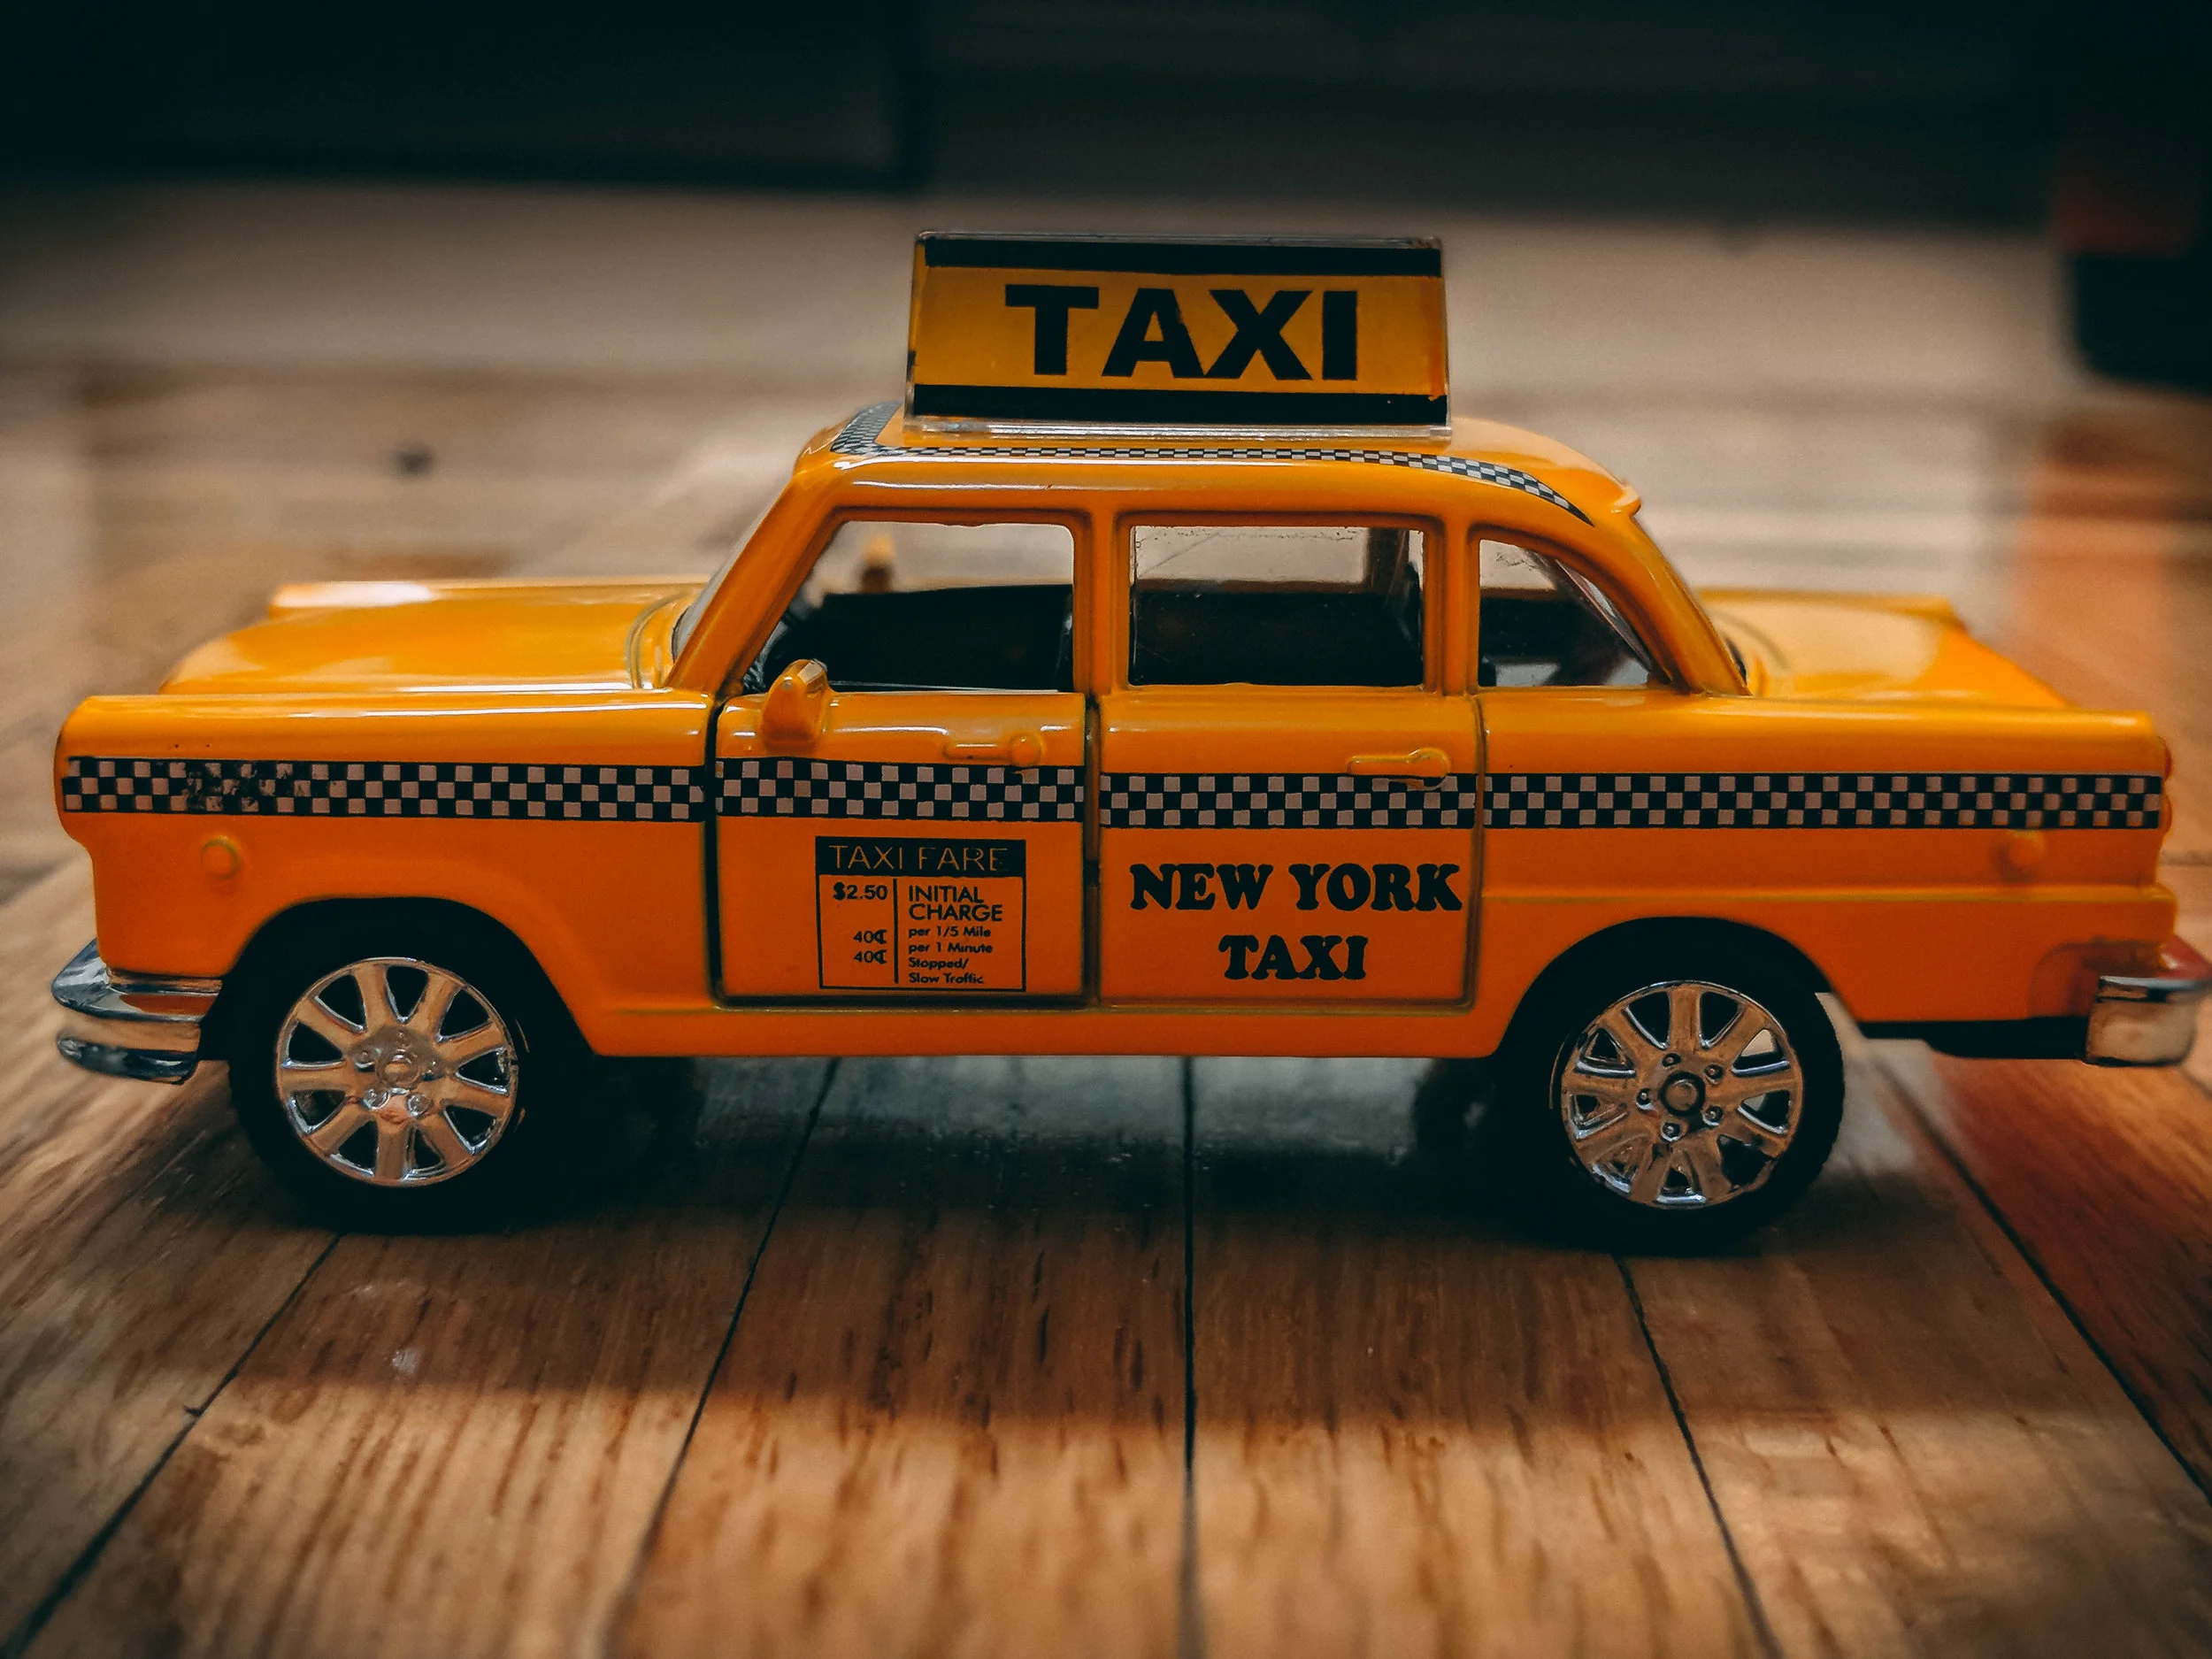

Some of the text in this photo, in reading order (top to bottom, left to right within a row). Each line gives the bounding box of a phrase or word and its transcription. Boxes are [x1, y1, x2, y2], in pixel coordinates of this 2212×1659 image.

[1005, 284, 1357, 380] TAXI
[829, 845, 1009, 872] TAXI FARE
[833, 881, 888, 901] $2.50
[909, 885, 984, 903] INITIAL
[1130, 864, 1463, 911] NEW YORK
[909, 903, 1003, 921] CHARGE
[909, 926, 991, 939] per 1/5 Mile
[909, 942, 993, 955] per 1 Minute
[1218, 935, 1368, 980] TAXI
[909, 957, 969, 971] Stopped/
[909, 972, 984, 984] Slow Traffic
